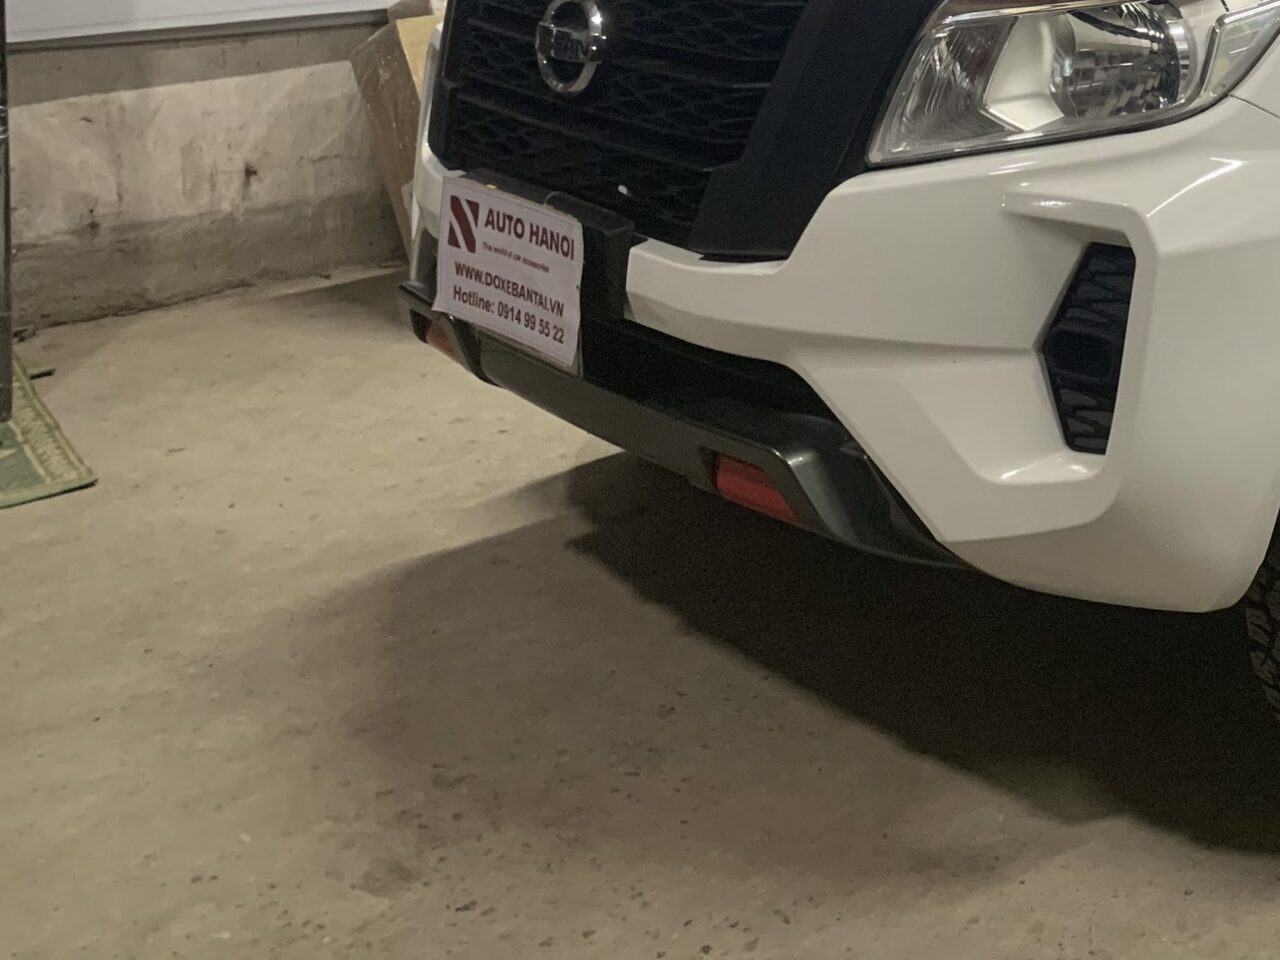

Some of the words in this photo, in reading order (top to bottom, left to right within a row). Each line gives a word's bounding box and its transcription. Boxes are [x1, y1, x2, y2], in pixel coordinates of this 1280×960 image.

[484, 207, 525, 240] AUTO
[529, 222, 575, 260] HANOI
[453, 285, 495, 314] Hotline:
[497, 301, 521, 326] 0914
[523, 311, 536, 331] 99
[538, 318, 550, 337] 55
[553, 325, 564, 344] 22
